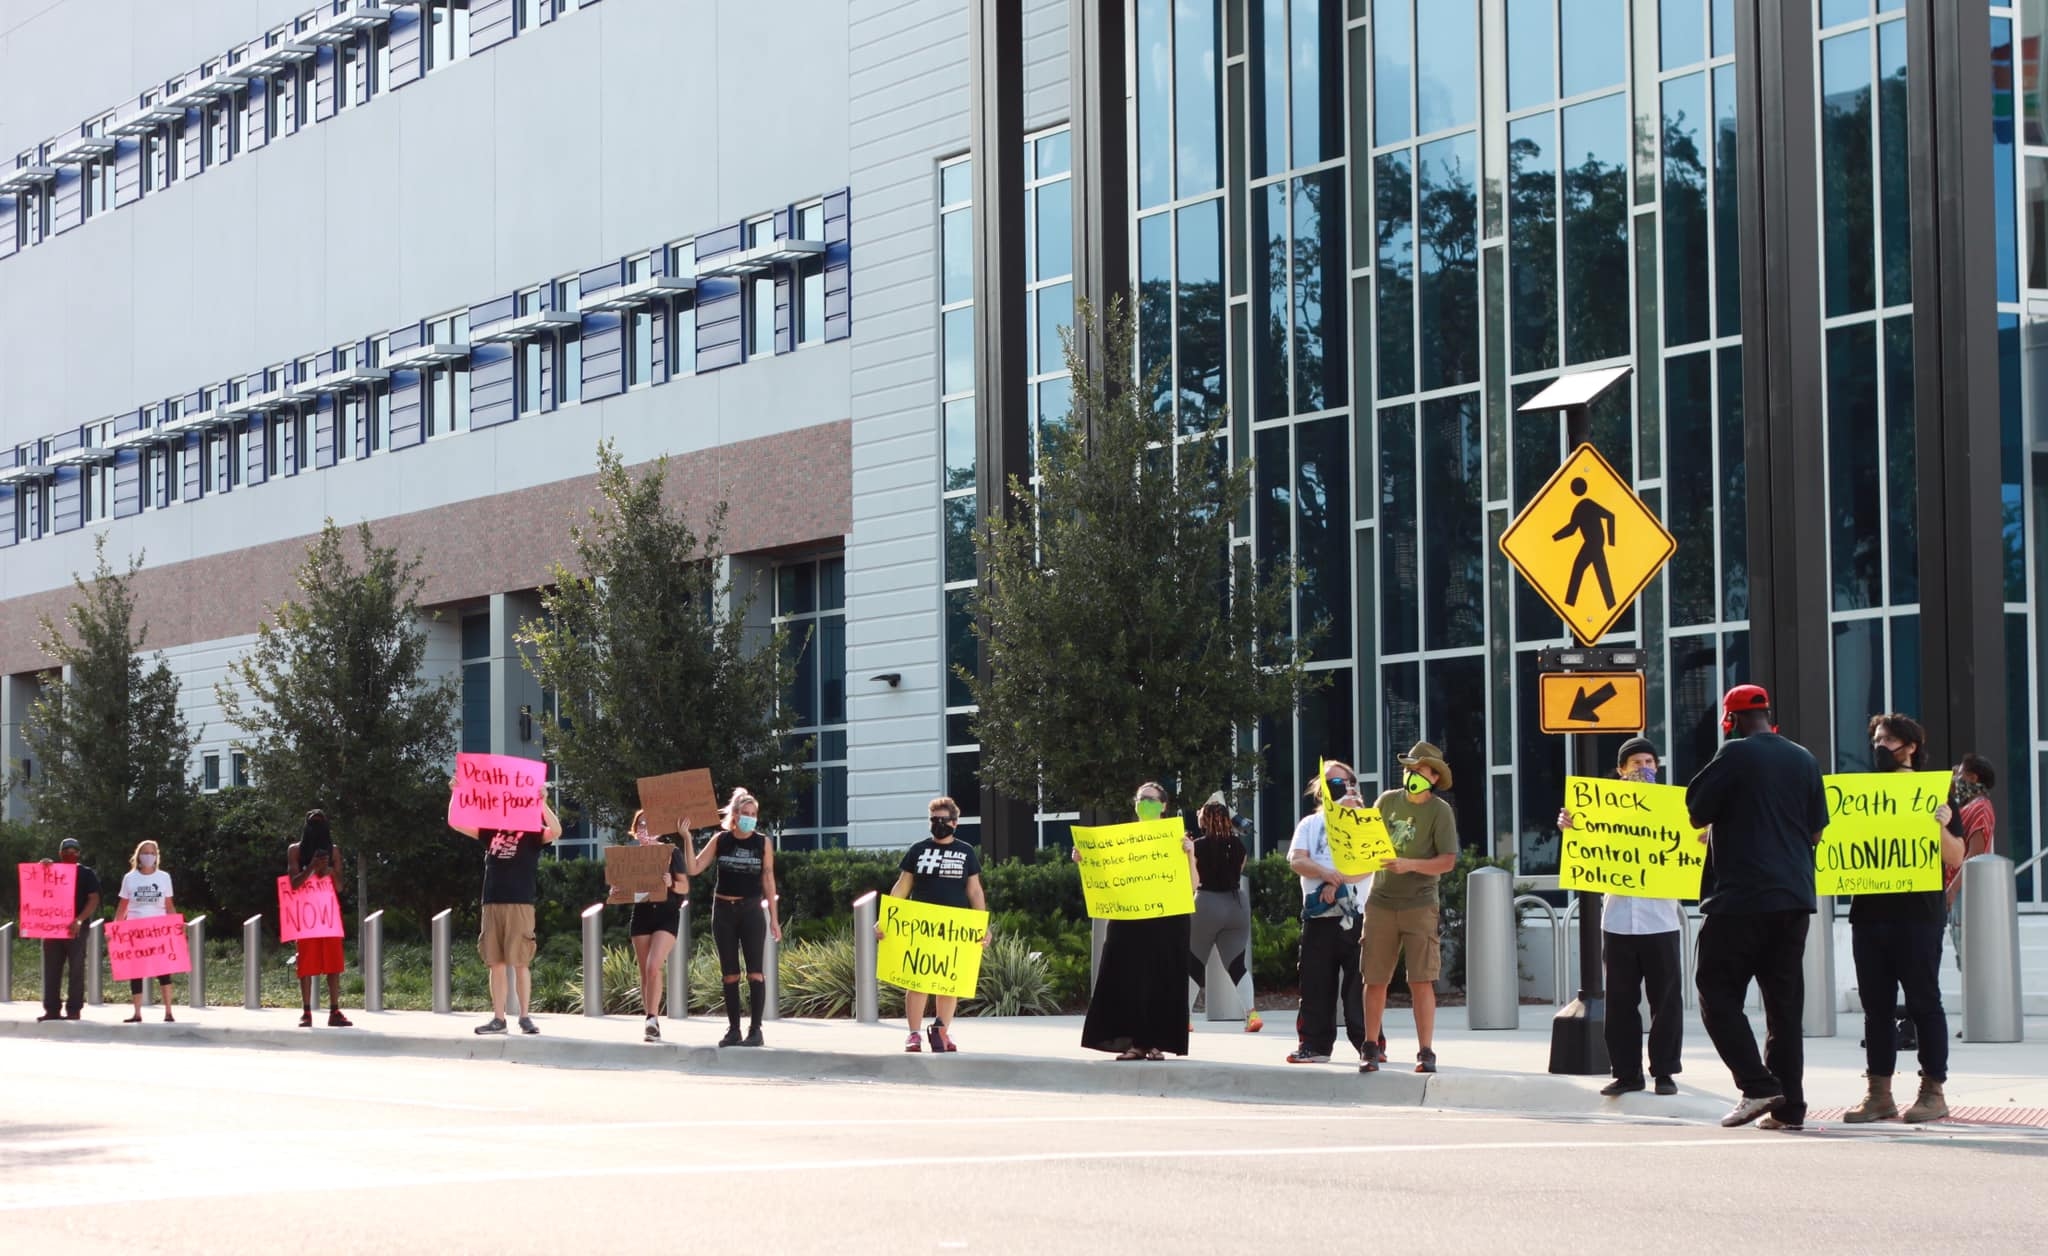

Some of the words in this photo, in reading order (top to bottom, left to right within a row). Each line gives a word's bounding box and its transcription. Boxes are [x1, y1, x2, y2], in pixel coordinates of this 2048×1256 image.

[463, 762, 508, 786] Death
[516, 771, 534, 788] to
[1573, 782, 1652, 812] Black
[1825, 785, 1897, 817] Death
[1910, 787, 1938, 814] to
[1571, 812, 1680, 854] Community
[1151, 850, 1169, 861] the
[1567, 841, 1640, 865] Control
[1649, 850, 1669, 866] of
[1678, 851, 1702, 867] the
[285, 896, 334, 932] NOW
[885, 906, 984, 946] Reparations
[111, 924, 185, 948] Reparations
[889, 970, 923, 988] George
